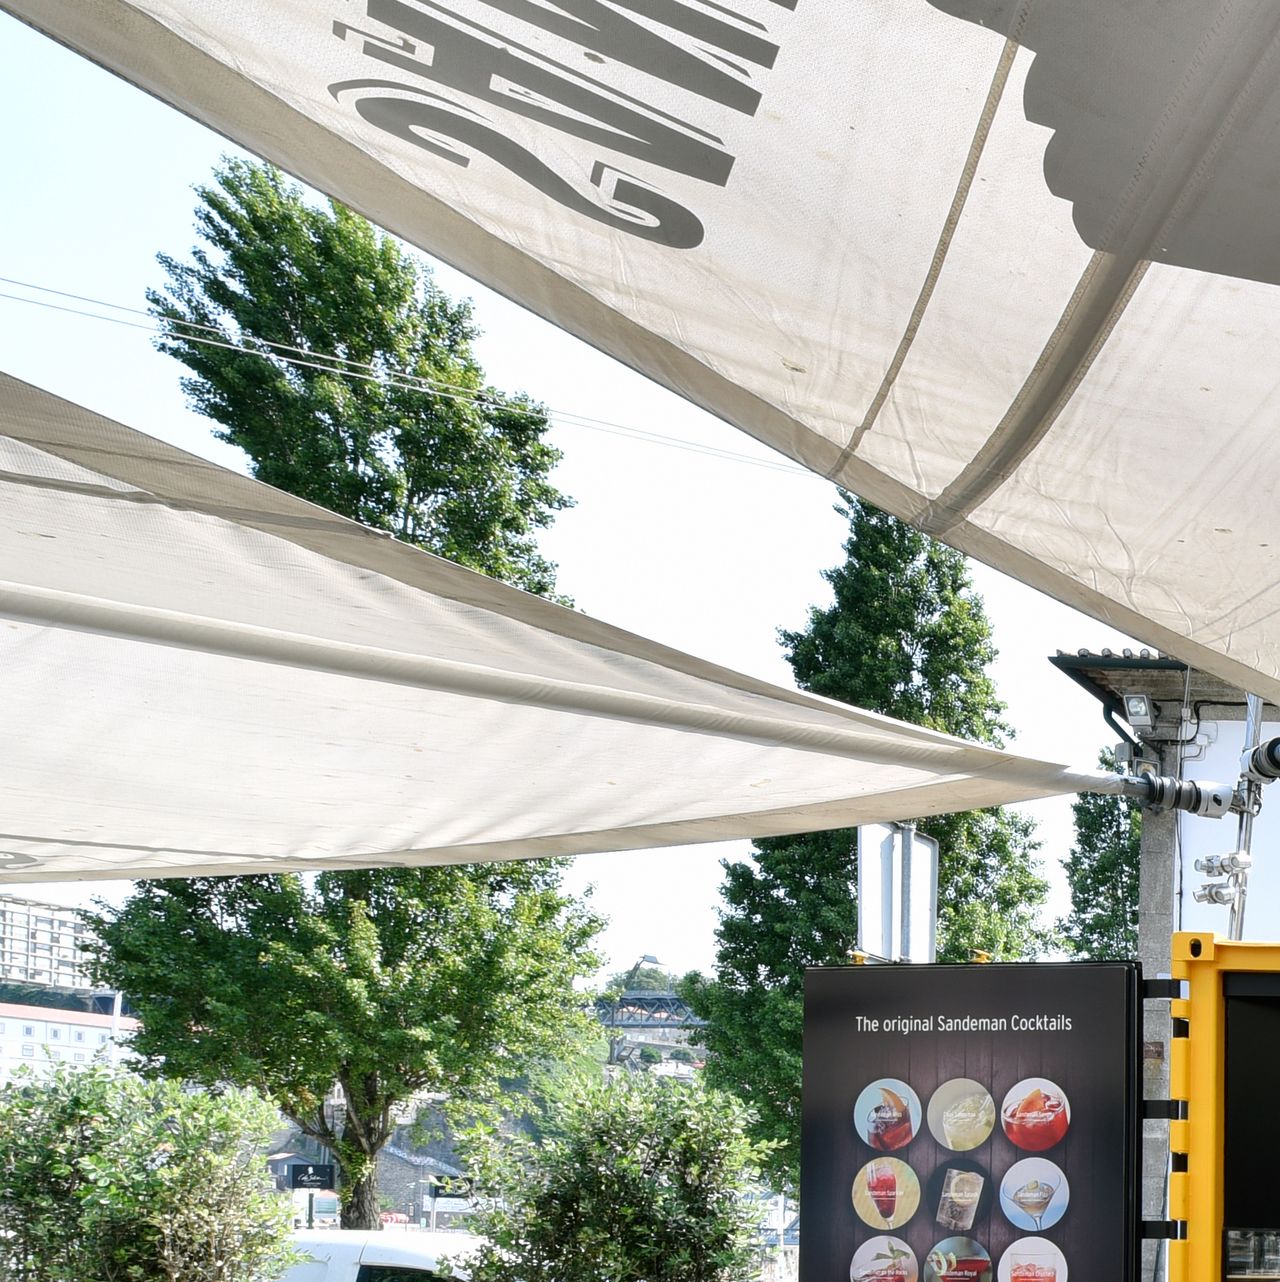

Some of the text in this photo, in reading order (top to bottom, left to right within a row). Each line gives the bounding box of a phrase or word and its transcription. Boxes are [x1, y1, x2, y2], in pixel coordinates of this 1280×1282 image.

[855, 1014, 1073, 1035] The original Sandeman Cocktails
